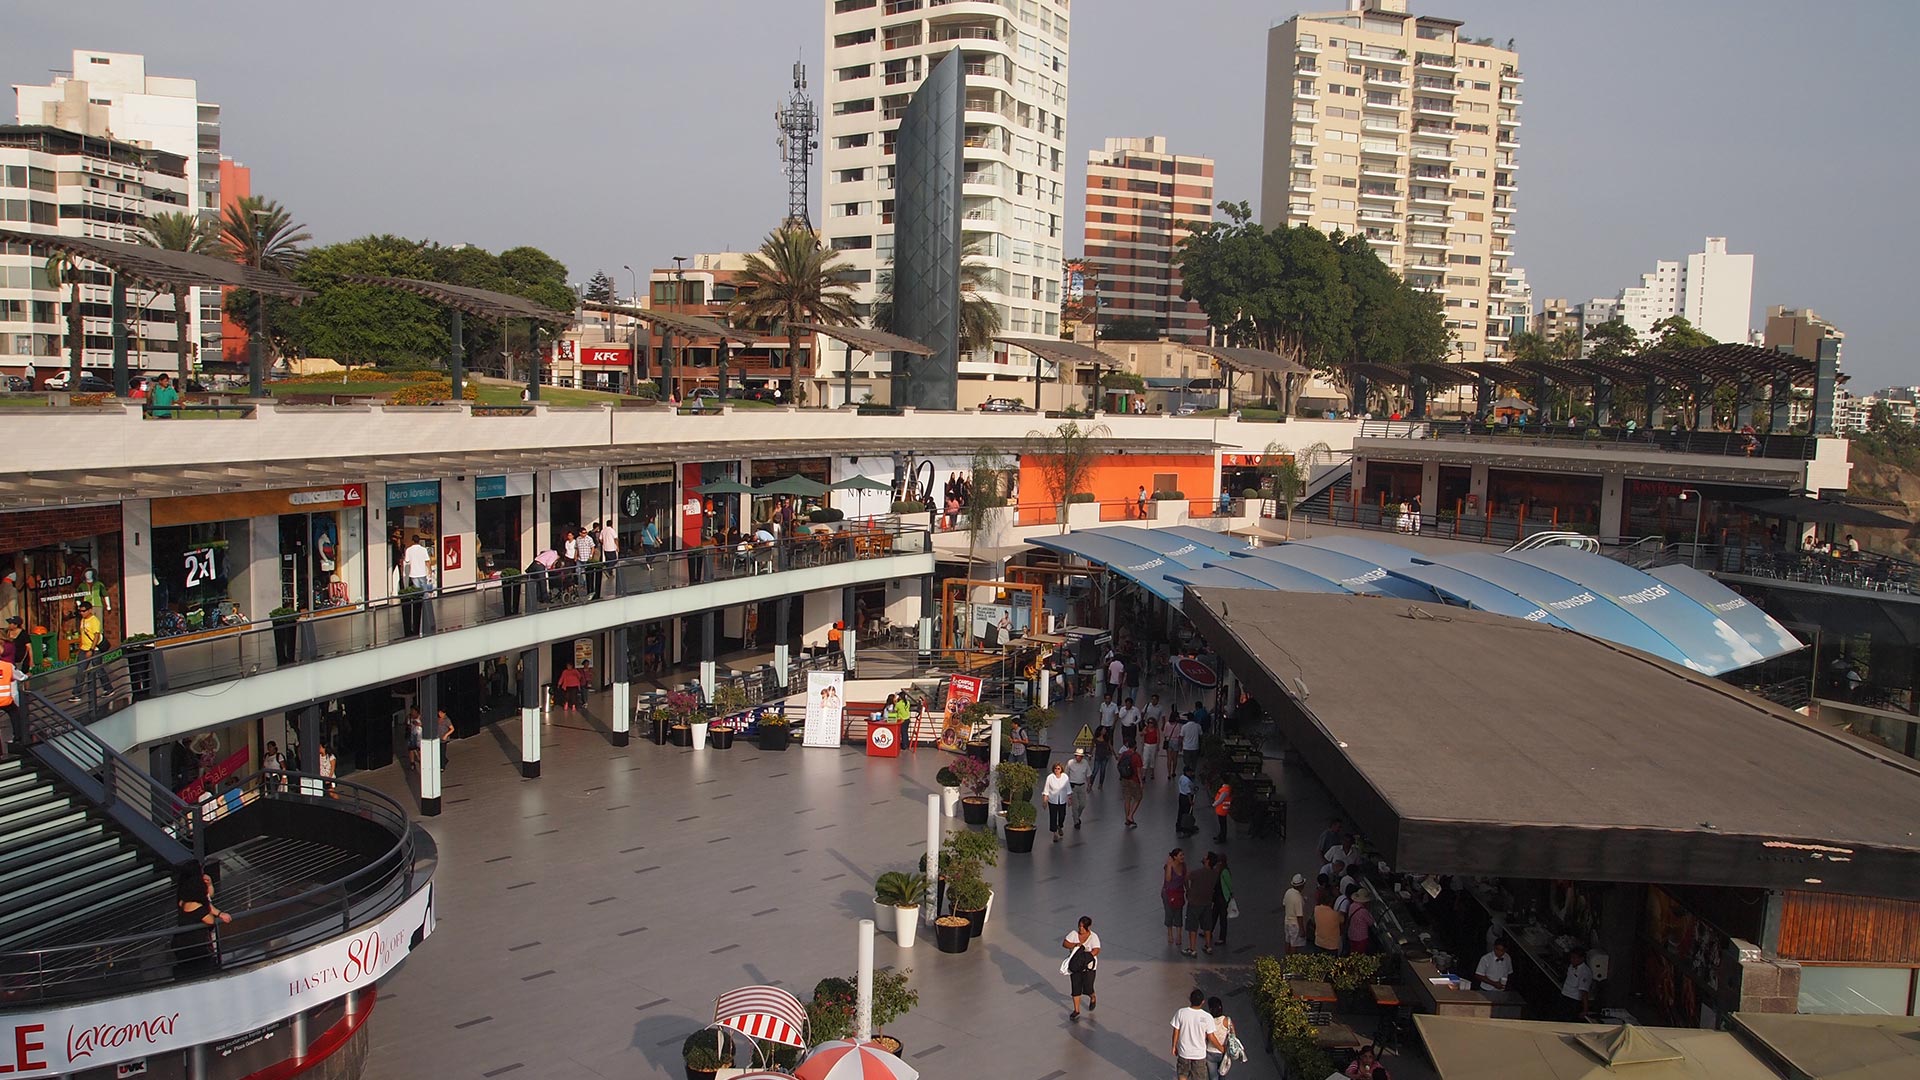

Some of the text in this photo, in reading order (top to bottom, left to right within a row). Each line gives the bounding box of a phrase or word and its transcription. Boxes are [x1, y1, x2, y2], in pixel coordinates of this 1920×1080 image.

[593, 352, 619, 361] KFC
[389, 490, 408, 500] Ibero
[185, 548, 216, 588] 2x1
[1550, 591, 1596, 611] movistar
[1619, 583, 1670, 605] movistar
[1717, 597, 1748, 612] movistar
[204, 765, 228, 785] Sale
[289, 966, 338, 996] HASTA
[389, 929, 405, 953] OFF
[67, 1012, 179, 1064] Larcomar
[118, 1061, 145, 1075] UVK
